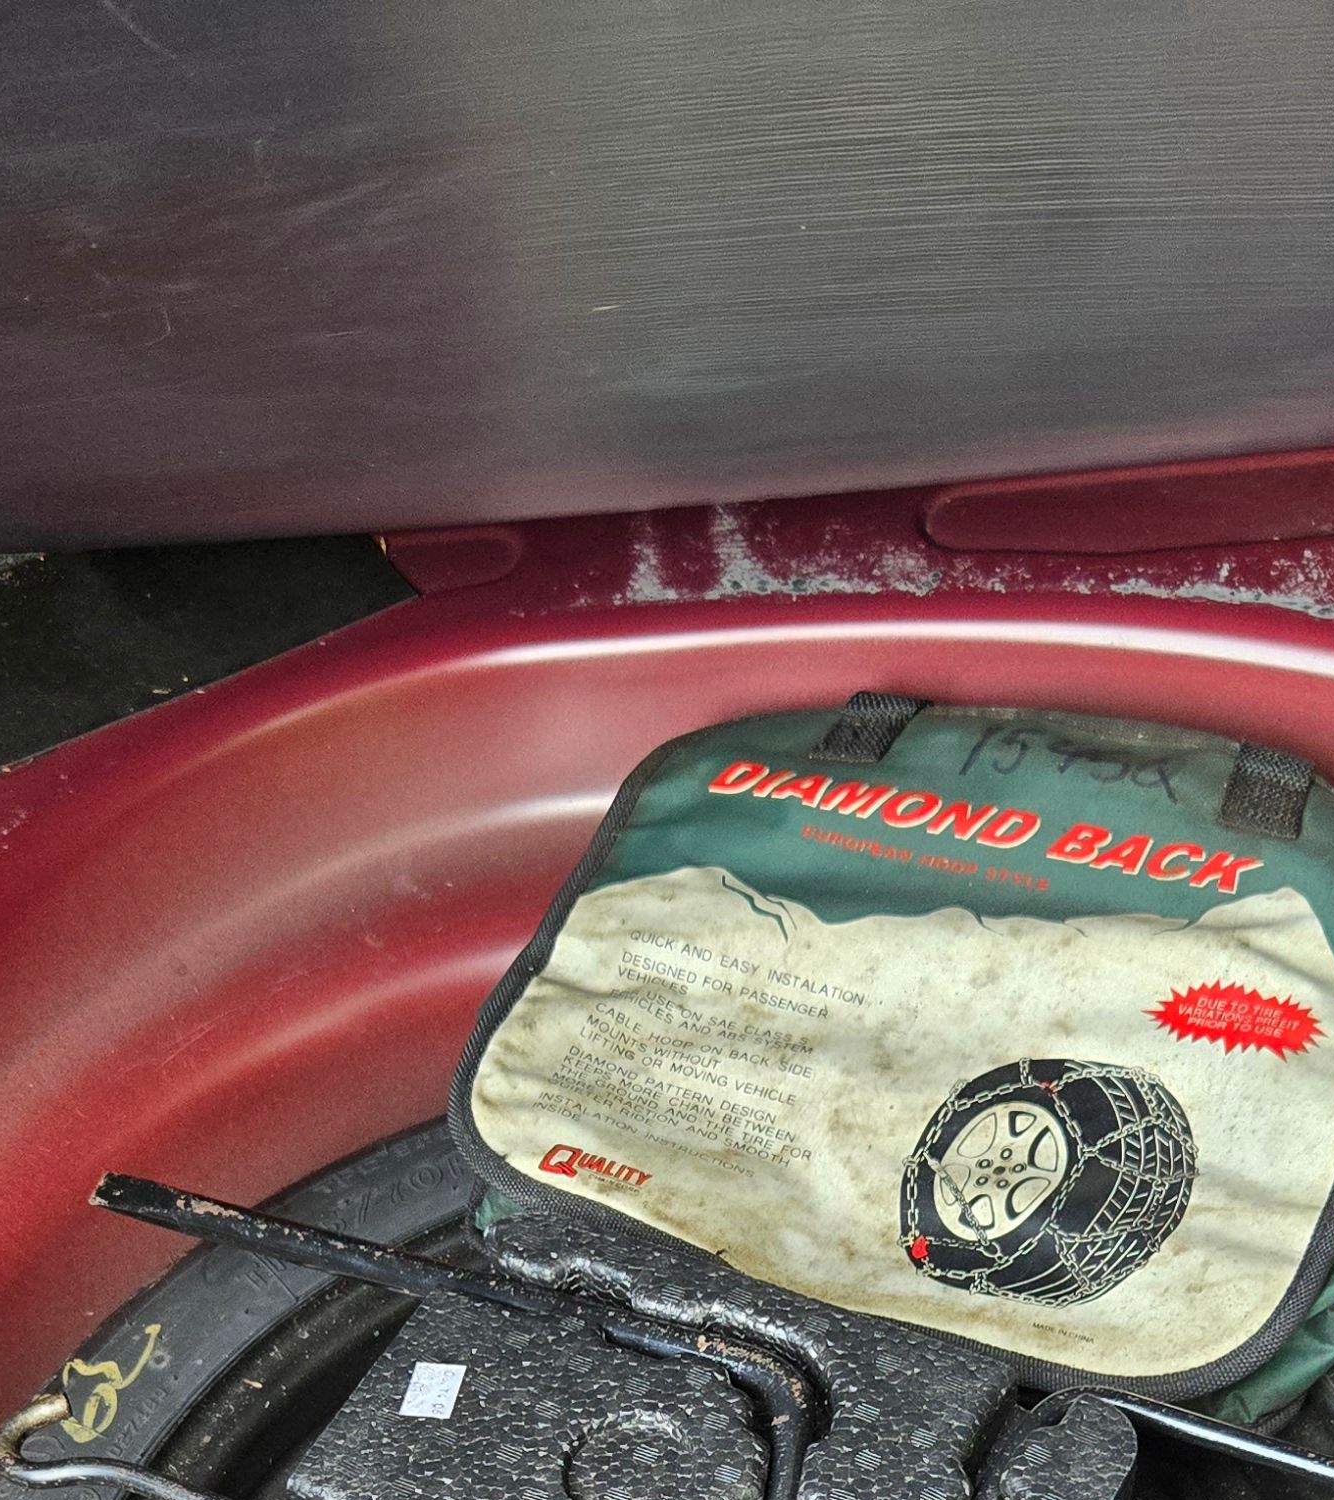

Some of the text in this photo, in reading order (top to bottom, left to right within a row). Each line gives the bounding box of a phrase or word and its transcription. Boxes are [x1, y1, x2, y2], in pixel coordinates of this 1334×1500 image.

[708, 759, 1041, 850] DIAMOND
[1046, 823, 1264, 894] BACK
[801, 824, 913, 863] EUROPEAN
[618, 966, 688, 996] VEHICLES
[622, 951, 828, 1019] DESIGNED FOR PASSENGER
[630, 930, 865, 1006] QUICK AND EASY INSTALATION
[647, 990, 676, 1011] USE
[680, 1008, 703, 1022] ON
[707, 1016, 736, 1030] SAE
[743, 1024, 791, 1041] CLASS
[1187, 1017, 1284, 1038] PRIOR TO USE
[1197, 996, 1283, 1019] DUE TO TIRE
[587, 1014, 721, 1070] MOUNTS WITHOUT
[595, 1002, 813, 1079] CABLE HOOP ON BACK SIDE
[679, 1020, 711, 1036] AND
[717, 1029, 744, 1043] ABS
[749, 1037, 814, 1055] SYSTEM
[569, 1045, 778, 1125] DIAMOND PATTERN DESIGN
[579, 1026, 797, 1106] LIFTING OR MOVING VEHICLE
[532, 1101, 581, 1122] INSIDE
[552, 1072, 792, 1168] MORE TRACTION AND SMOOTH
[559, 1064, 814, 1162] THE GROUND AND THE TIRE FOR
[563, 1055, 797, 1144] KEEPS MORE CHAIN BETWEEN
[620, 1107, 653, 1127] RIDE
[538, 1091, 755, 1178] INSTALATION INSTRUCTIONS
[538, 1144, 653, 1186] QUALITY
[1033, 1322, 1056, 1333] MADE
[1068, 1332, 1094, 1344] CHINA
